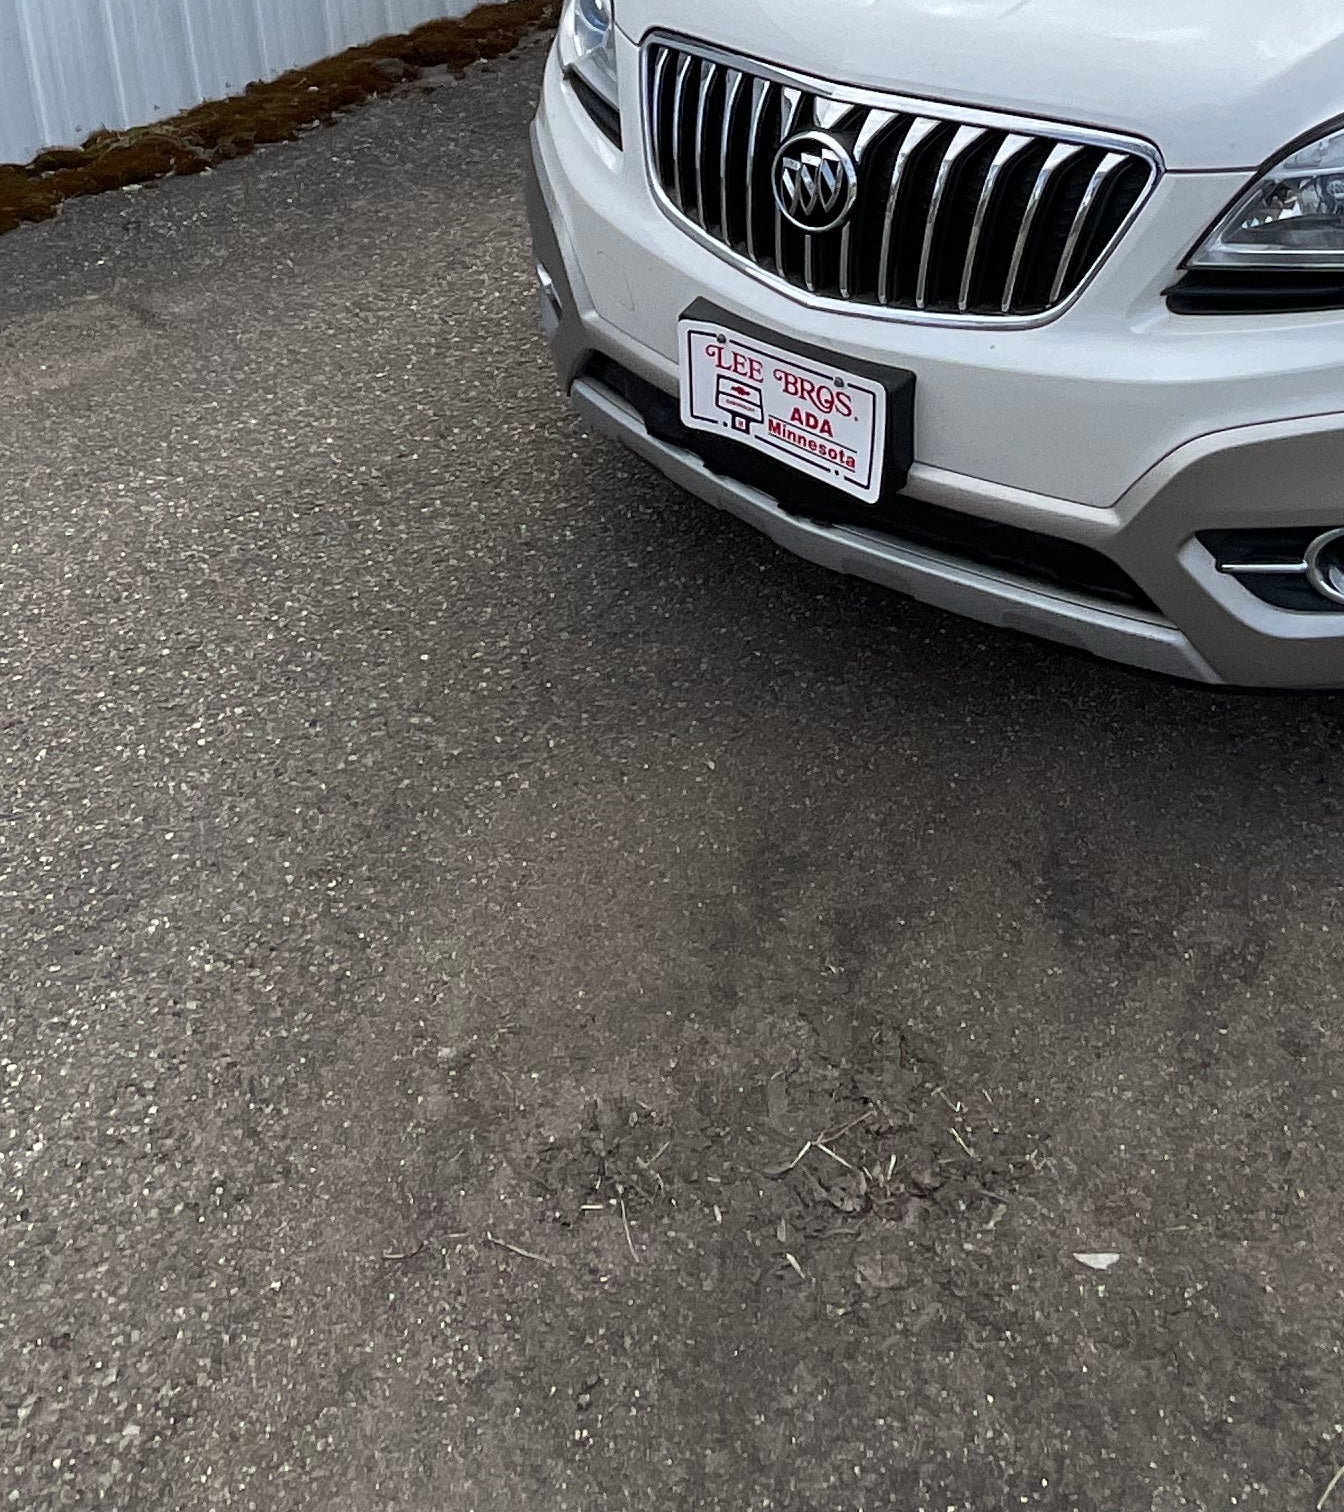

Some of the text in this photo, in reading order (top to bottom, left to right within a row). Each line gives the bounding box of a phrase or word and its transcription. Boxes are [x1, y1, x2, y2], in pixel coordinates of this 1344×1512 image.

[705, 344, 764, 383] LEE
[789, 407, 834, 438] ADA
[768, 418, 857, 469] Minnesota
